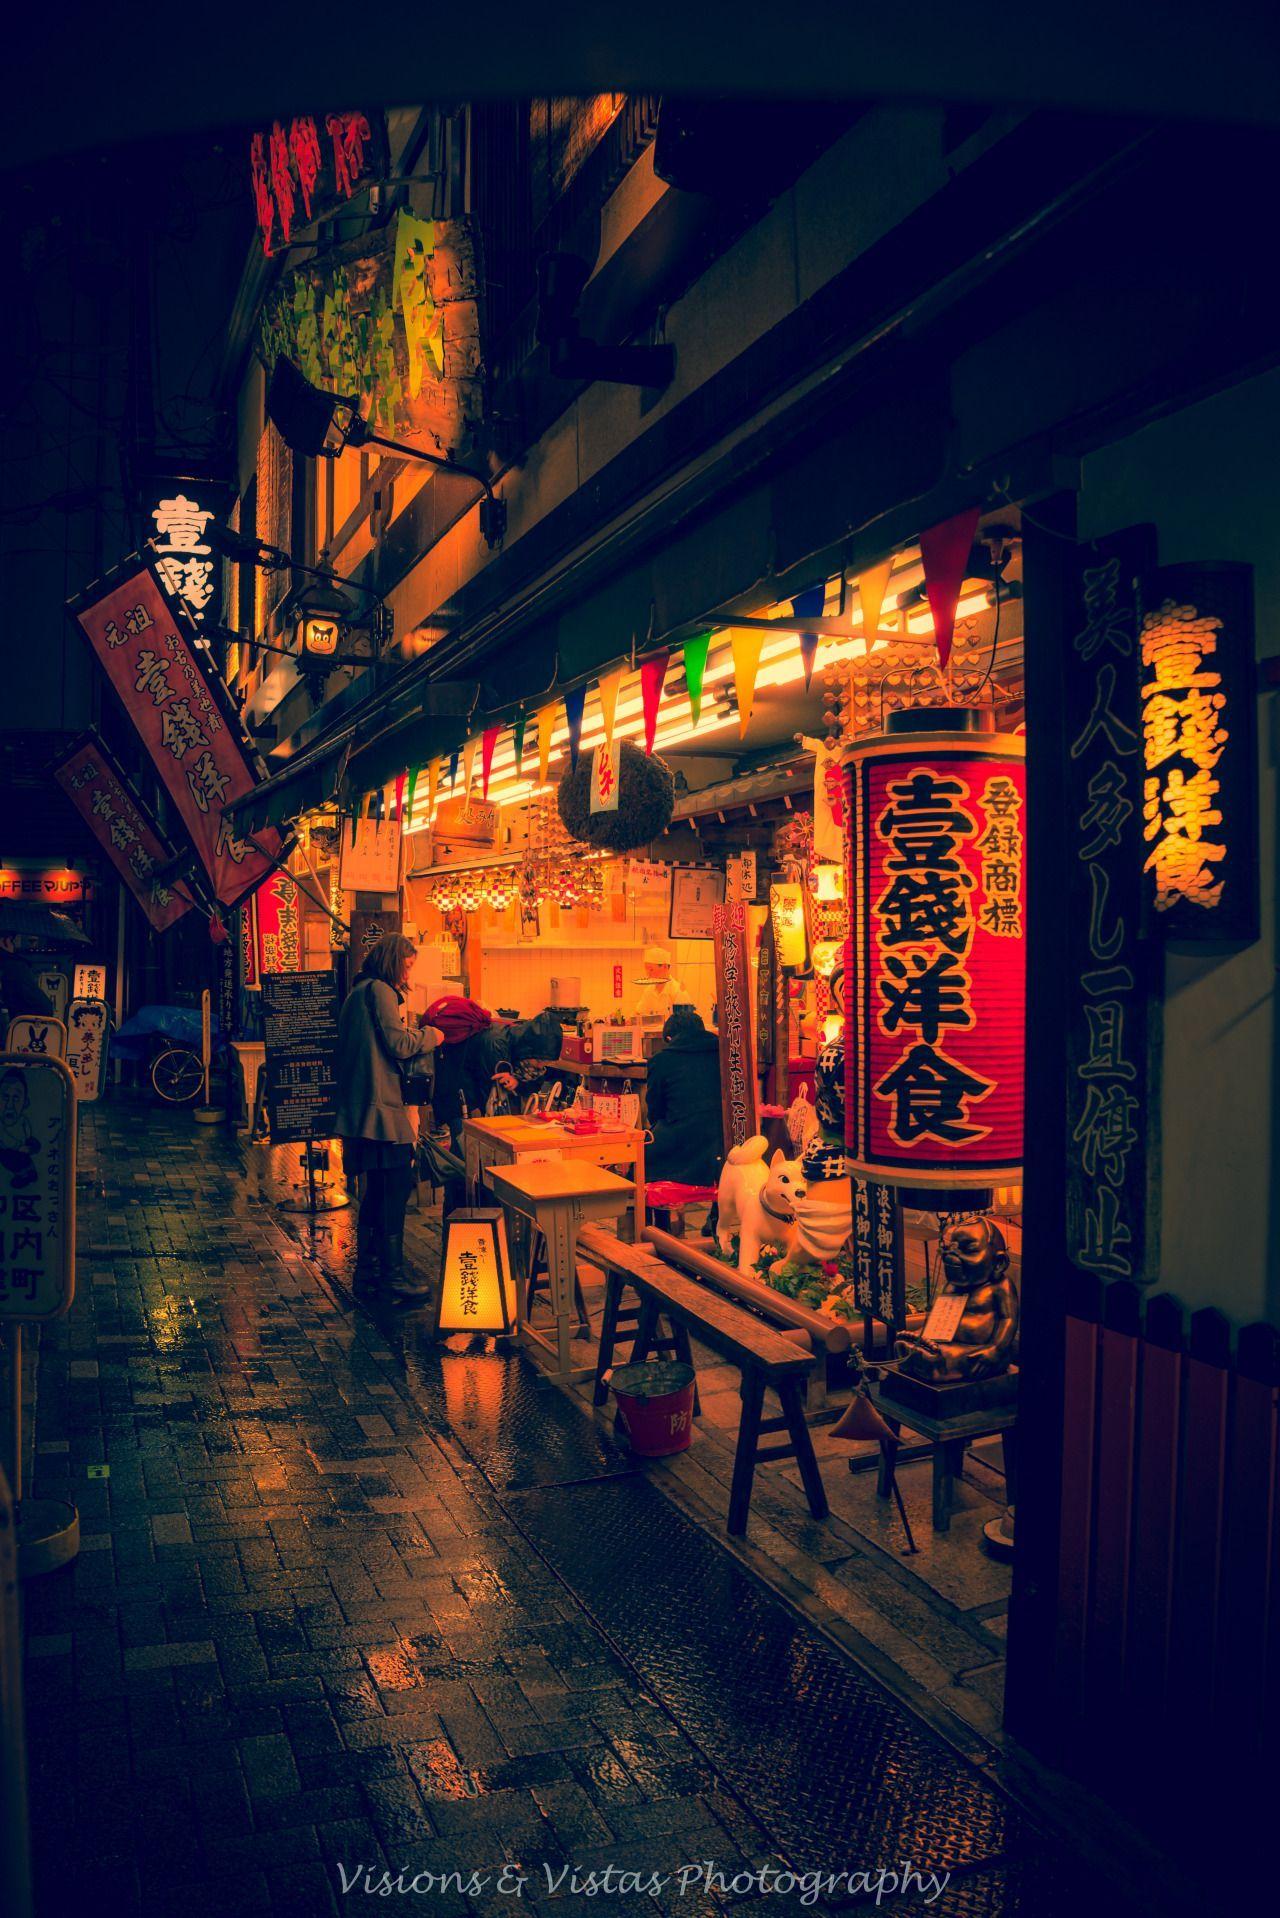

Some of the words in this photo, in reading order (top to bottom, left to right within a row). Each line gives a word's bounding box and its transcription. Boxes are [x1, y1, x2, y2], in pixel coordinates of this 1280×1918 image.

[105, 604, 154, 649] 元祖
[0, 880, 42, 893] FFEE
[977, 777, 1022, 936] 登録商標
[1071, 557, 1139, 1275] 美人多し一旦停止
[11, 1194, 44, 1301] 区内町
